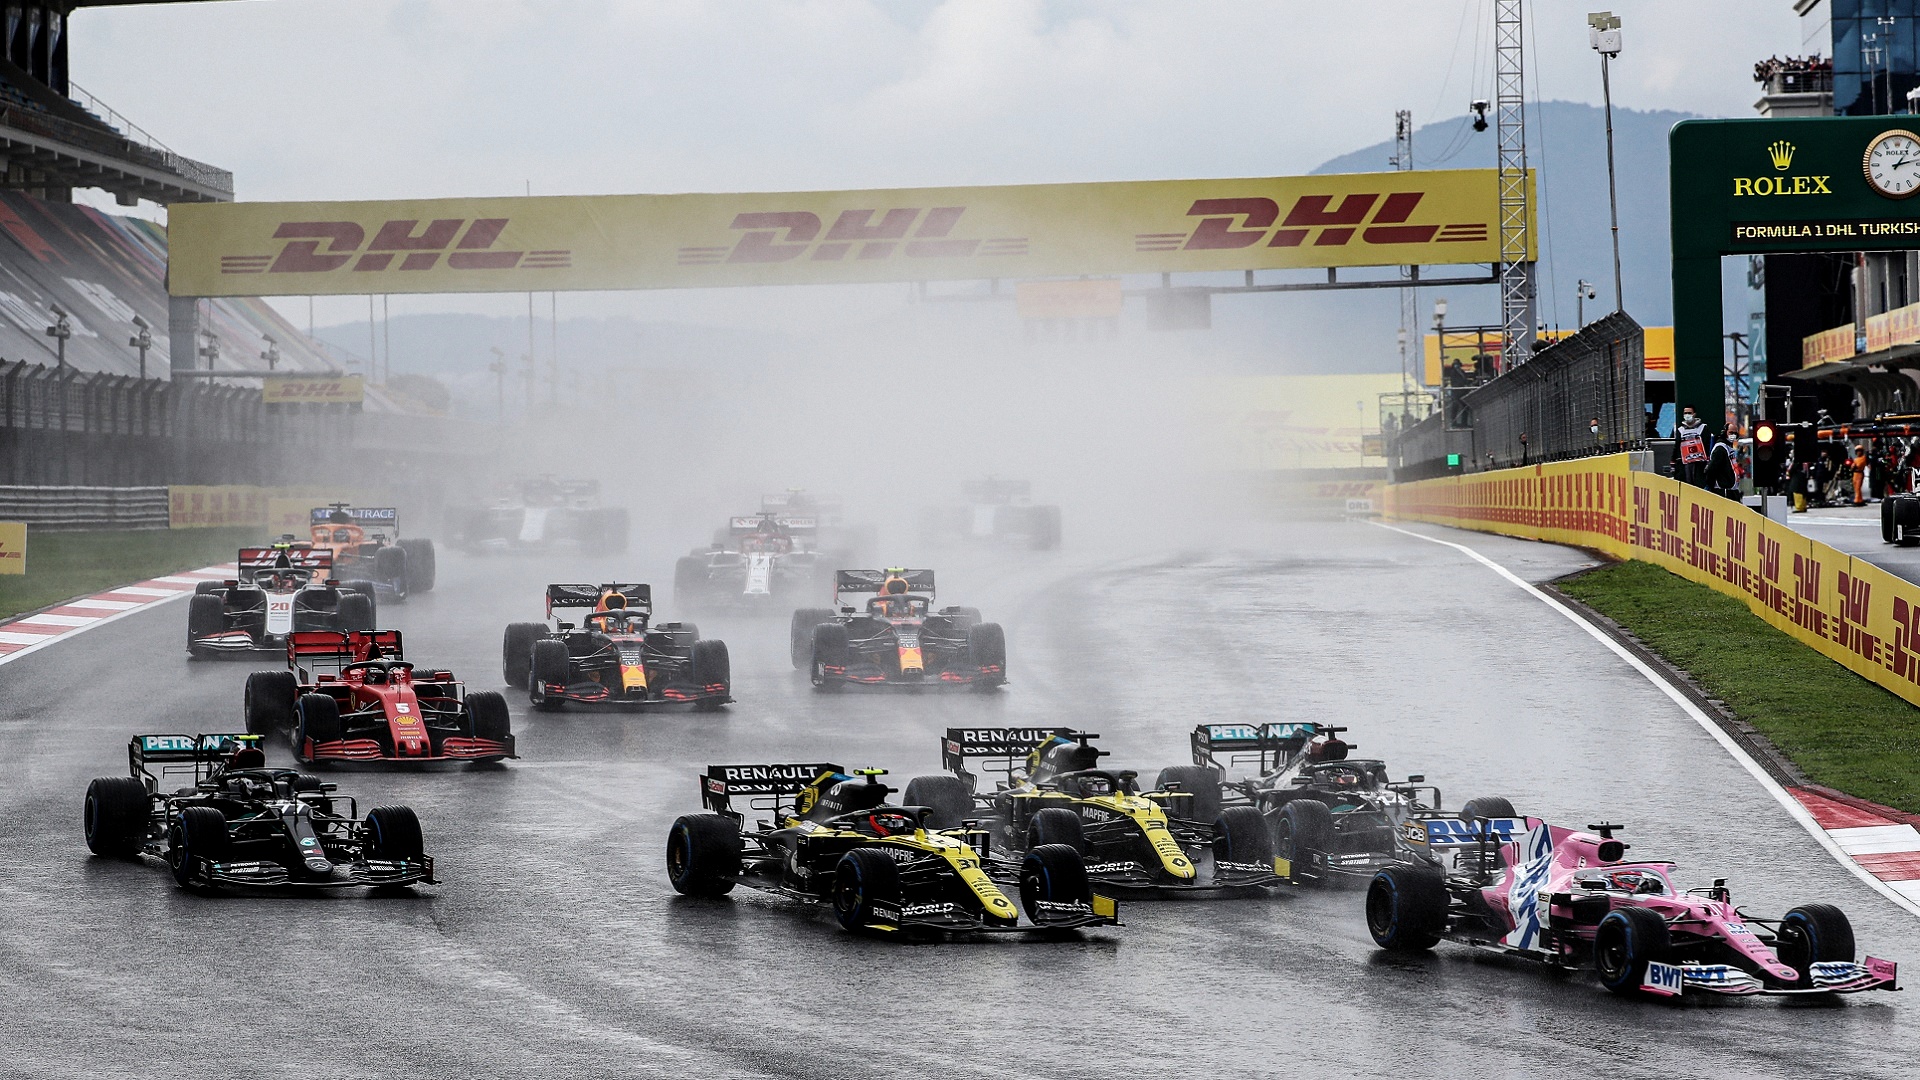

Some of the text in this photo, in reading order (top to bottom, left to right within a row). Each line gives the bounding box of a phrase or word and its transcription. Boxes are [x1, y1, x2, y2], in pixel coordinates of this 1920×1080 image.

[1733, 176, 1832, 196] ROLEX
[1183, 192, 1441, 250] DHL
[726, 207, 982, 263] DHL
[1736, 225, 1812, 238] FORMULA
[1815, 225, 1824, 236] 1
[1826, 224, 1857, 236] DHL
[268, 218, 524, 273] DHL
[281, 383, 344, 397] DHL
[270, 602, 290, 611] 20
[1838, 570, 1875, 661] DHL
[395, 702, 411, 714] 5
[963, 730, 1055, 742] RENAULT
[1210, 724, 1304, 738] PETRNA
[146, 735, 247, 749] PETRN
[725, 766, 818, 780] RENAULT
[1082, 806, 1110, 821] MAPFRE
[1406, 826, 1426, 841] JCB
[1650, 963, 1681, 989] BWT
